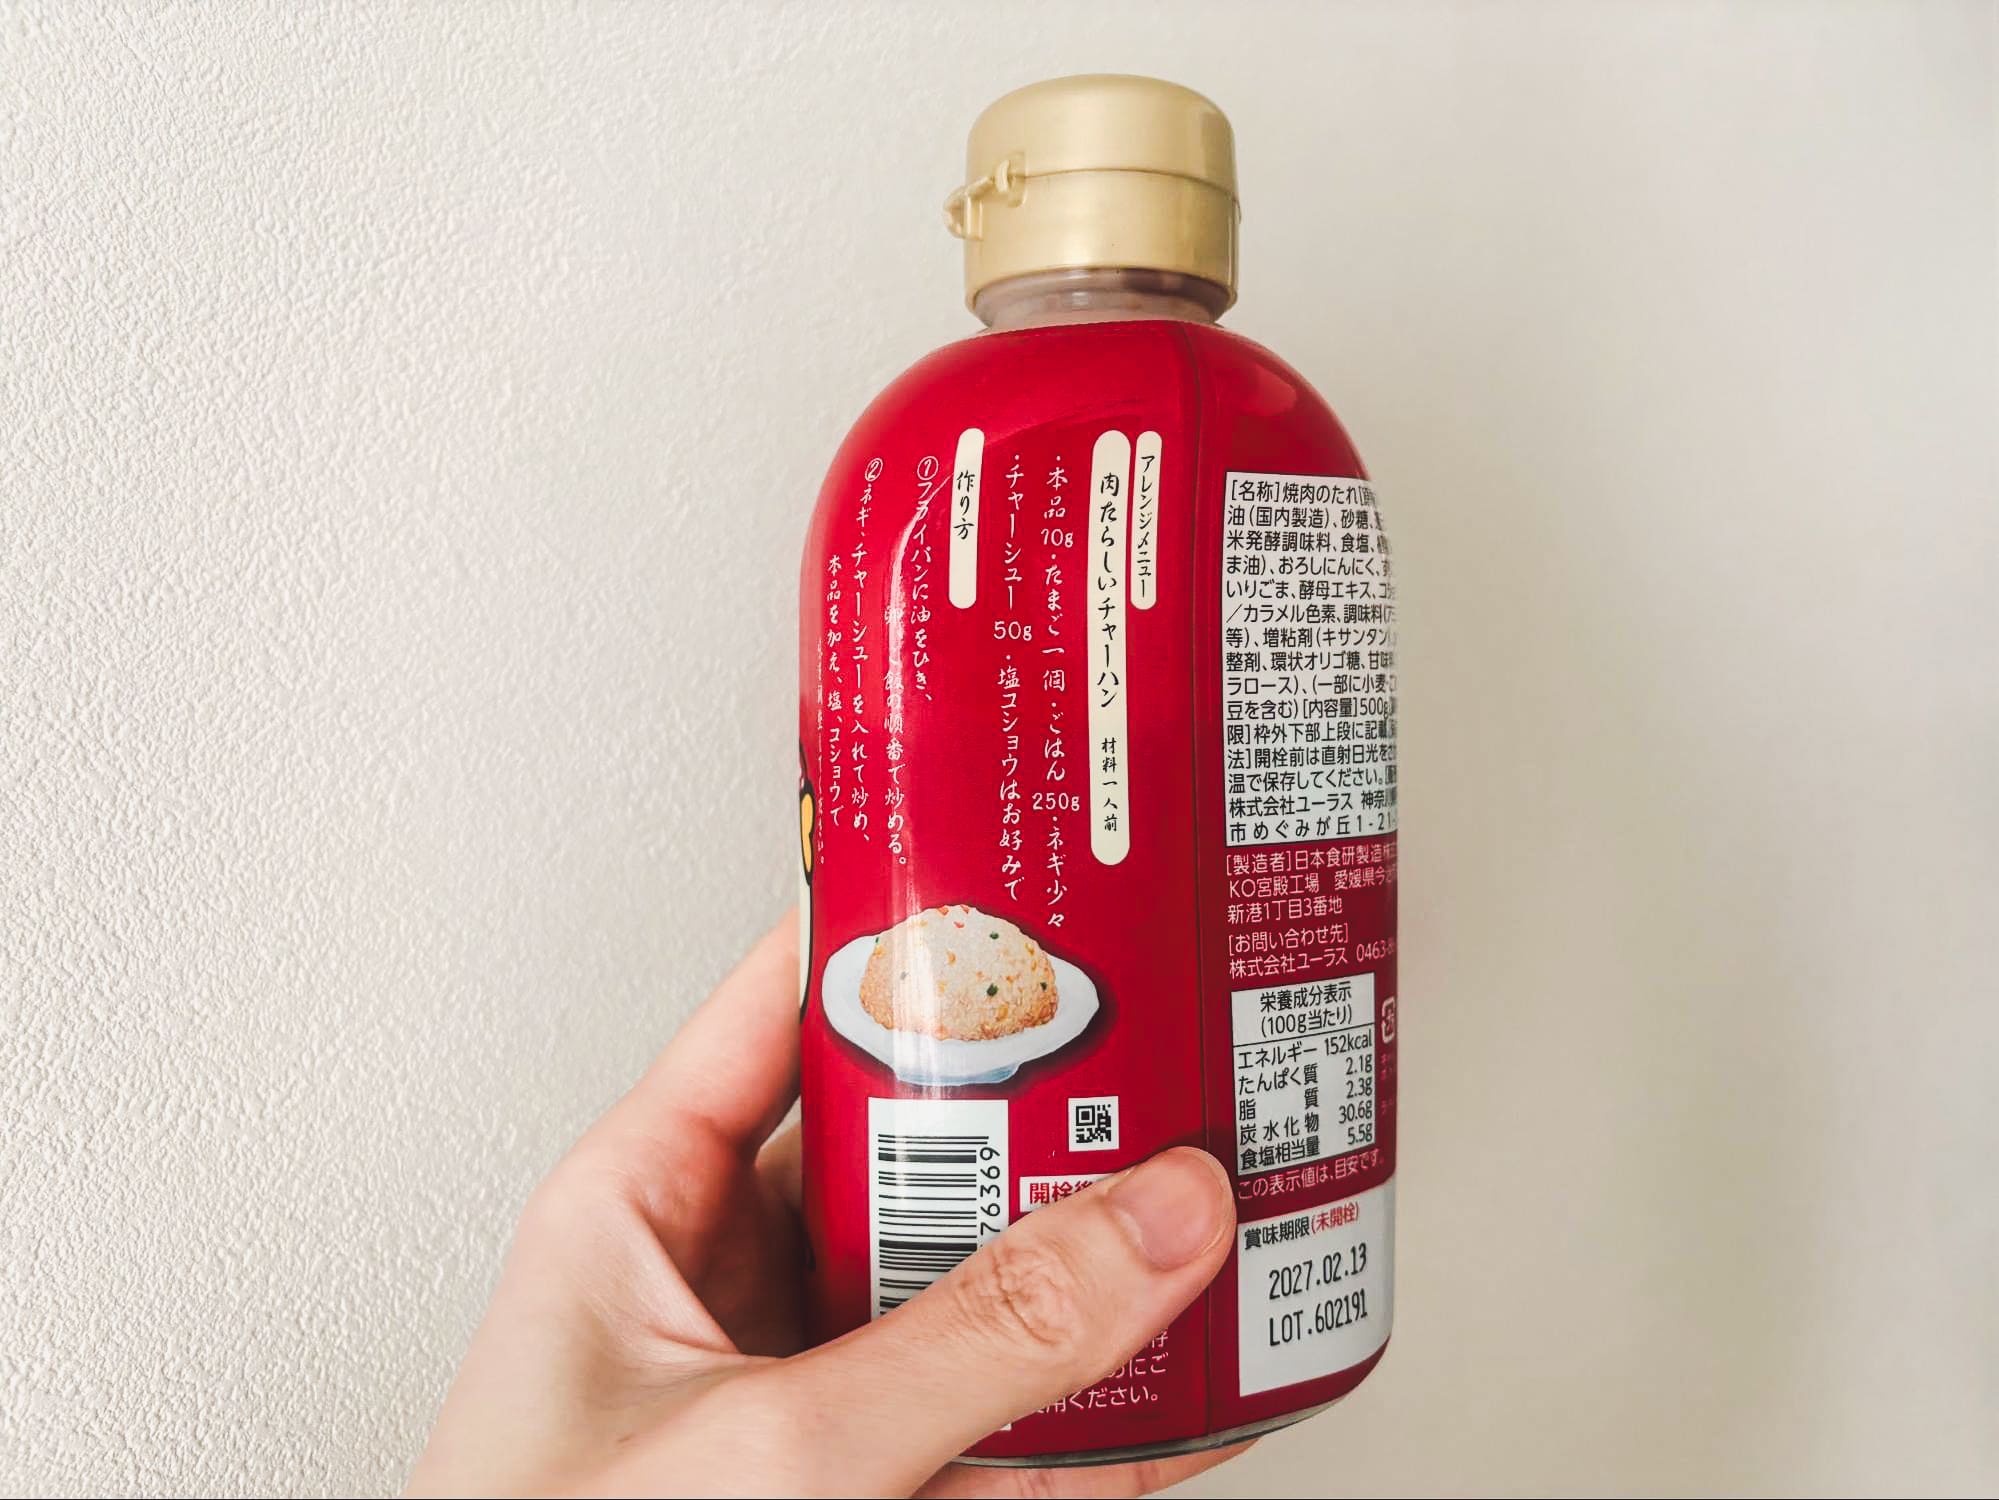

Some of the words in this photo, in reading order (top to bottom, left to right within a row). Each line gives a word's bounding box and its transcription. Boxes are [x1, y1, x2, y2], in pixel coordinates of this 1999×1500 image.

[953, 471, 976, 541] 作り方
[1227, 505, 1384, 531] 油(国内製造)、砂糖、
[1137, 455, 1156, 598] アレンジメニュー
[1097, 471, 1120, 708] 肉たらしいチャーハン
[1226, 627, 1396, 648] 等)、増粘剤(キサンタン
[1227, 697, 1396, 721] 豆を含む)[内容量]500g
[1101, 737, 1119, 833] 材料一人前
[1229, 791, 1354, 818] 株式会社ユーラス
[1229, 873, 1320, 898] KO宮殿工場
[1227, 896, 1343, 925] 新港1丁目3番地
[1228, 922, 1349, 956] [お問い合わせ先]
[1229, 947, 1348, 979] 株式会社ユーラス
[1260, 980, 1353, 1014] 栄養成分表示
[1261, 1003, 1353, 1038] (100g当たり)
[1238, 1041, 1318, 1070] エネルギー
[1324, 1029, 1373, 1057] 152kcal
[1238, 1062, 1318, 1096] たんぱく質
[1346, 1054, 1373, 1075] 2.1g
[1346, 1077, 1373, 1099] 2.3g
[1339, 1100, 1373, 1125] 30.6g
[1240, 1135, 1320, 1171] 食塩相当量
[1347, 1122, 1373, 1146] 5.5g
[980, 1147, 1001, 1238] 76369
[1268, 1242, 1368, 1300] 2027.02.13
[1268, 1288, 1368, 1347] LOT.602191
[1036, 1385, 1159, 1414] 用ください。
